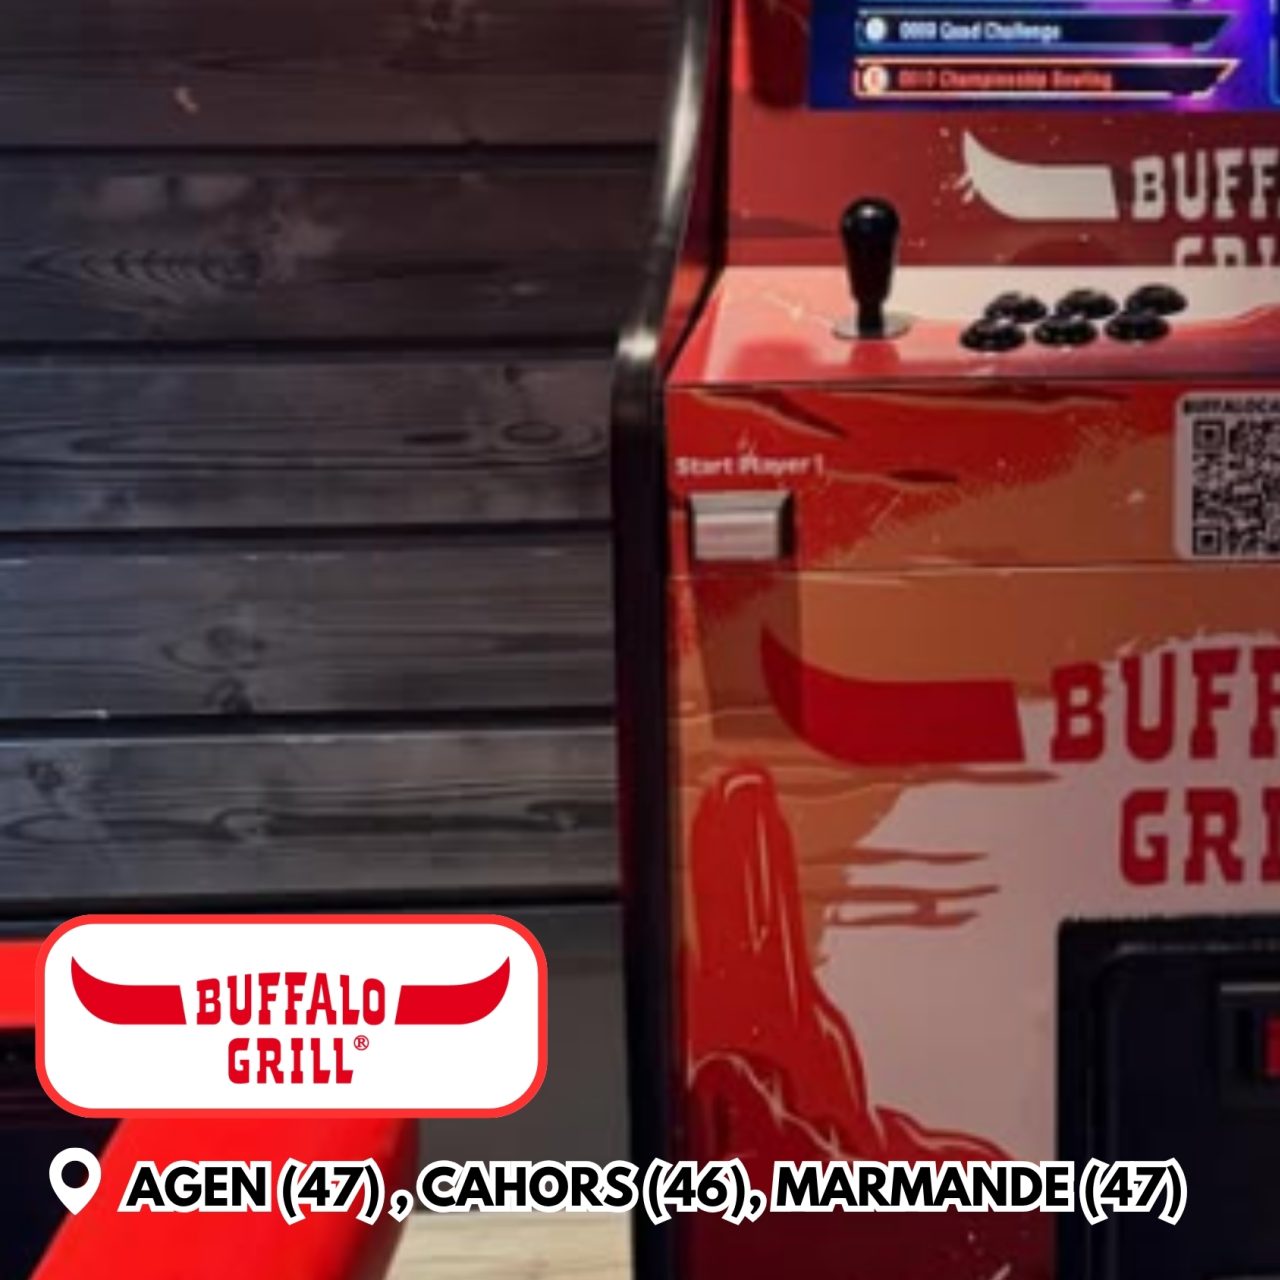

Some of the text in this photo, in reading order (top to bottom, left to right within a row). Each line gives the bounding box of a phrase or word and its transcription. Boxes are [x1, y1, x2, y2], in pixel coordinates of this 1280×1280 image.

[984, 22, 1062, 45] Challenge
[675, 456, 734, 475] Start
[738, 455, 811, 478] Player
